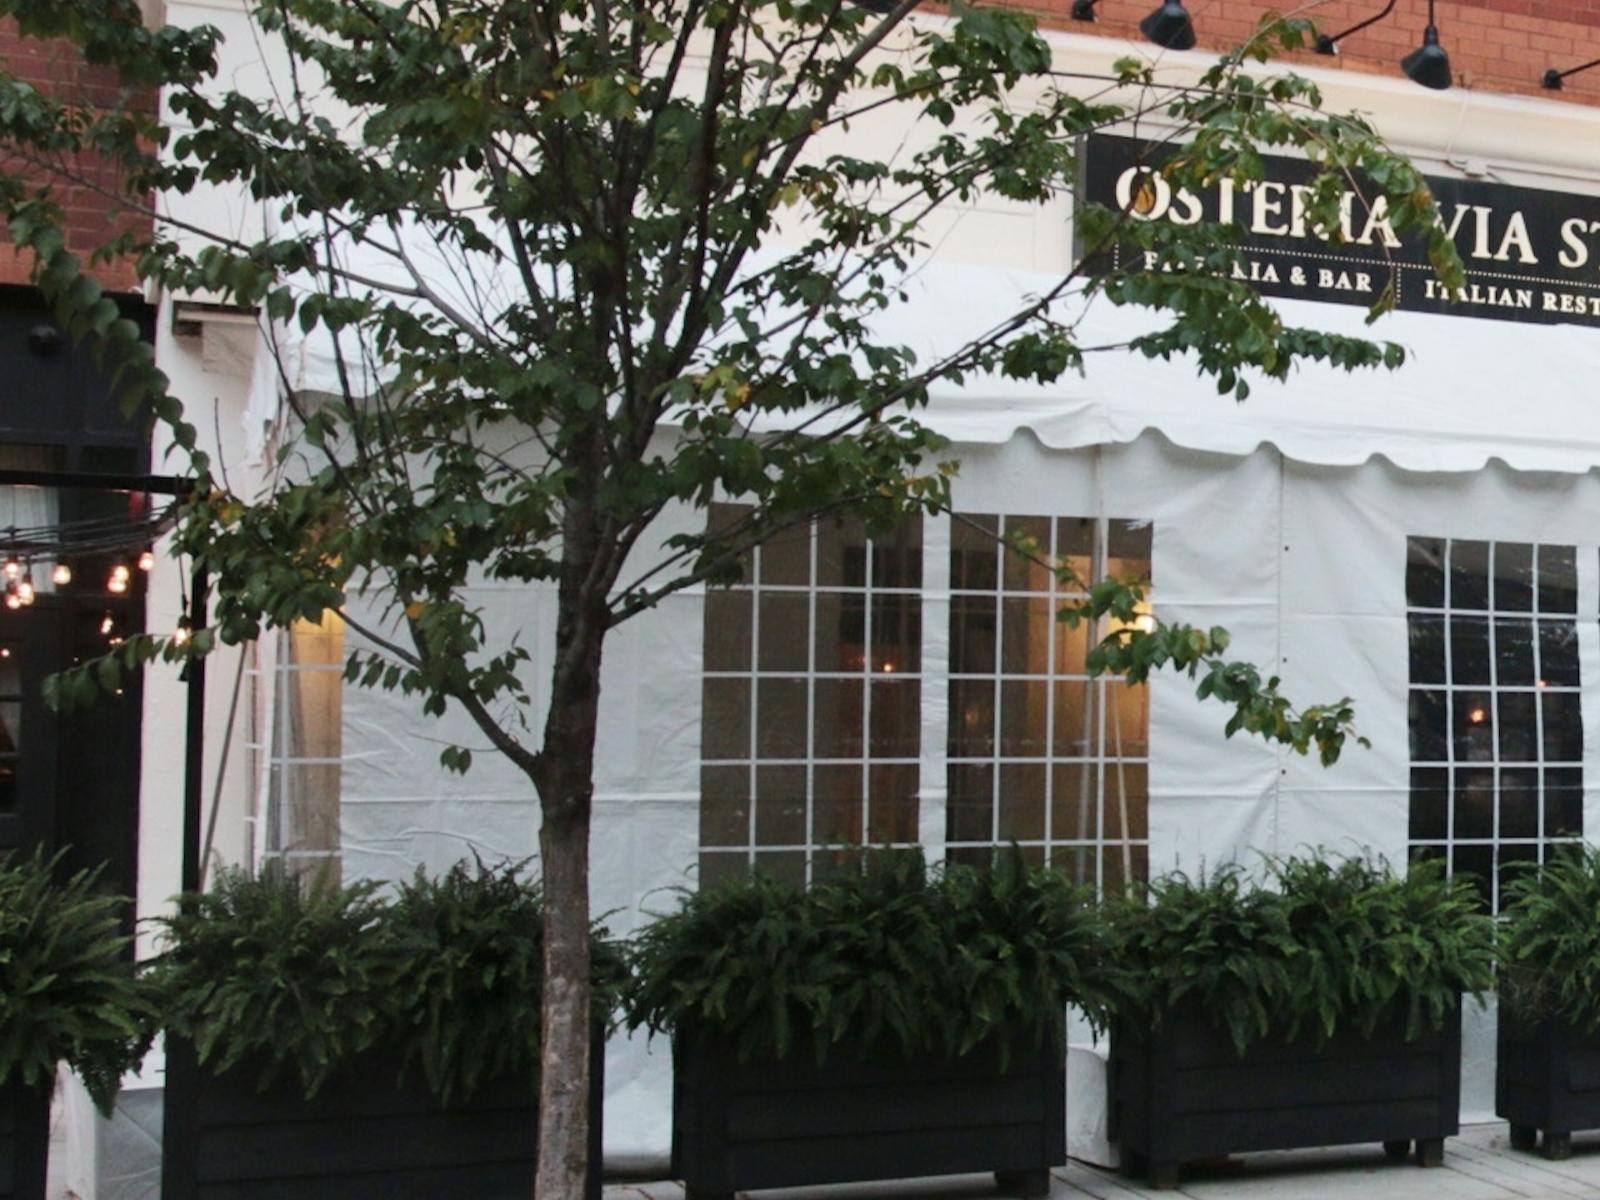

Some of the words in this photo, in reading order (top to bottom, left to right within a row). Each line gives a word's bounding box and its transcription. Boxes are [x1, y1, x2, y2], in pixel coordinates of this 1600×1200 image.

[1433, 202, 1539, 265] VIA
[1289, 266, 1308, 286] &
[1317, 268, 1373, 292] BAR
